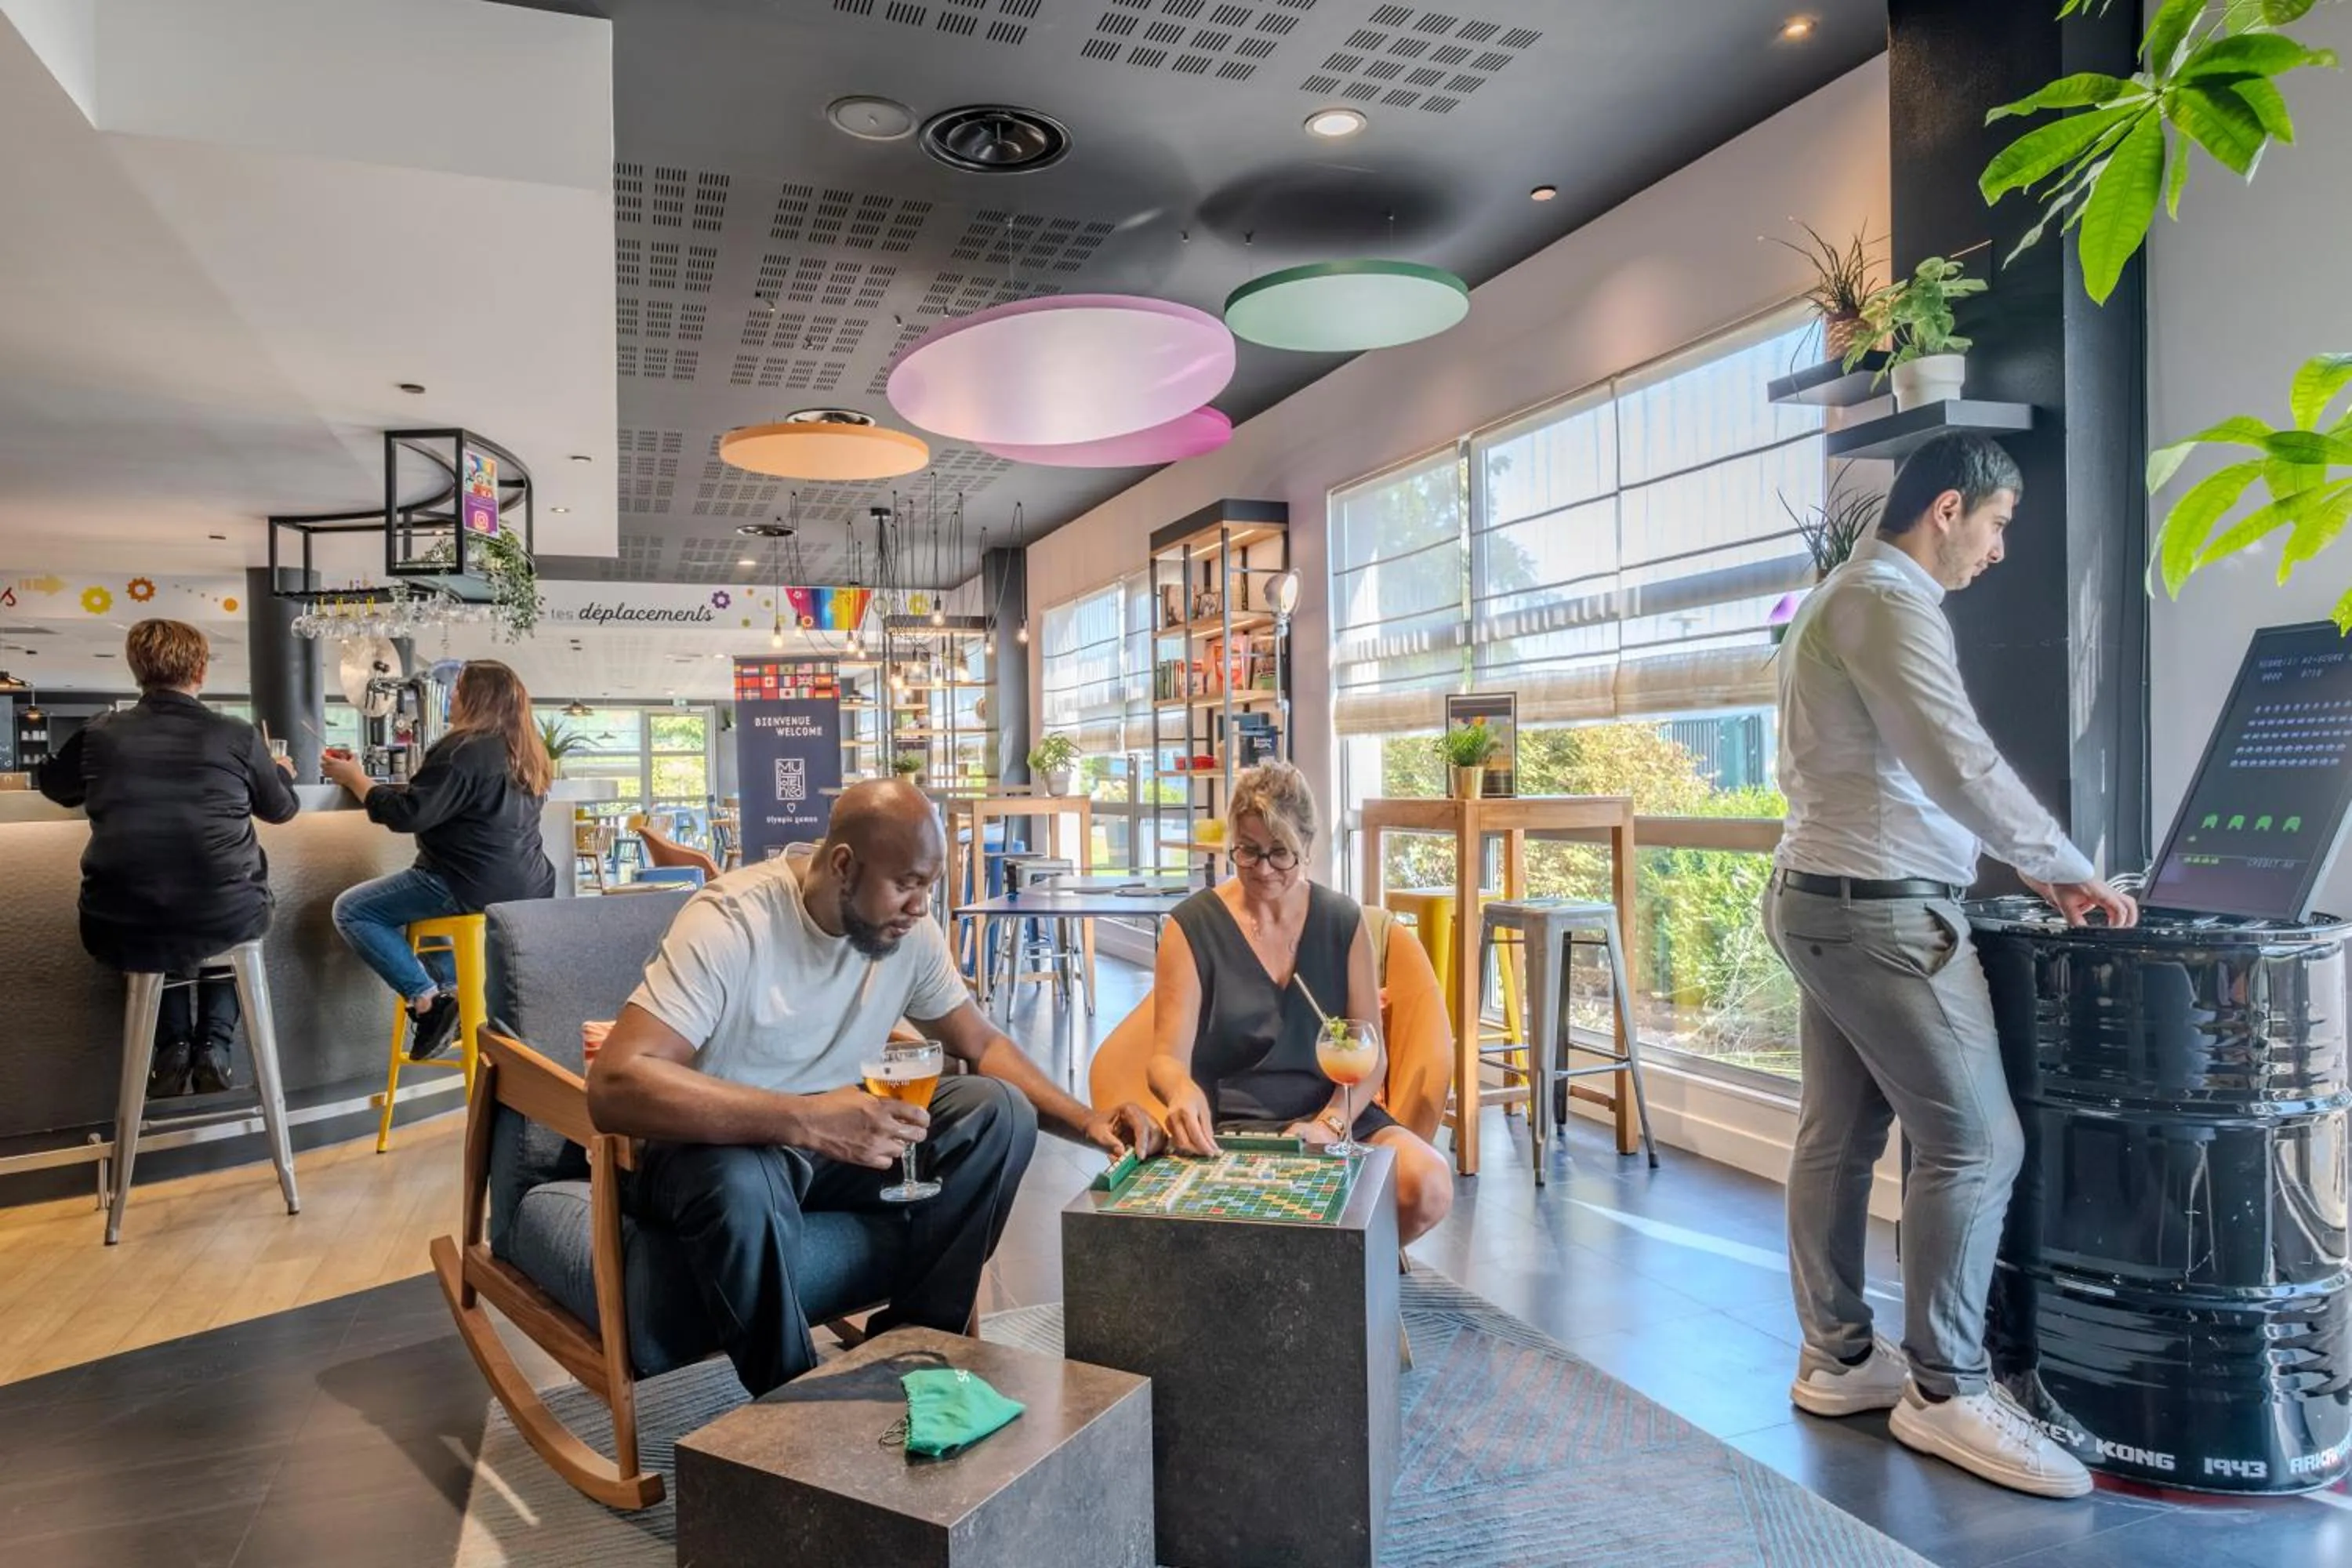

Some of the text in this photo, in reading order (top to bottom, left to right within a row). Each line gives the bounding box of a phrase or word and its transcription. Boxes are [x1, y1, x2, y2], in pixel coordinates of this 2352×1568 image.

[579, 602, 715, 625] déplacements
[754, 717, 811, 727] BIENVENUE
[775, 726, 822, 736] WELCOME
[2095, 1438, 2176, 1472] KONG
[2204, 1457, 2268, 1479] 1943
